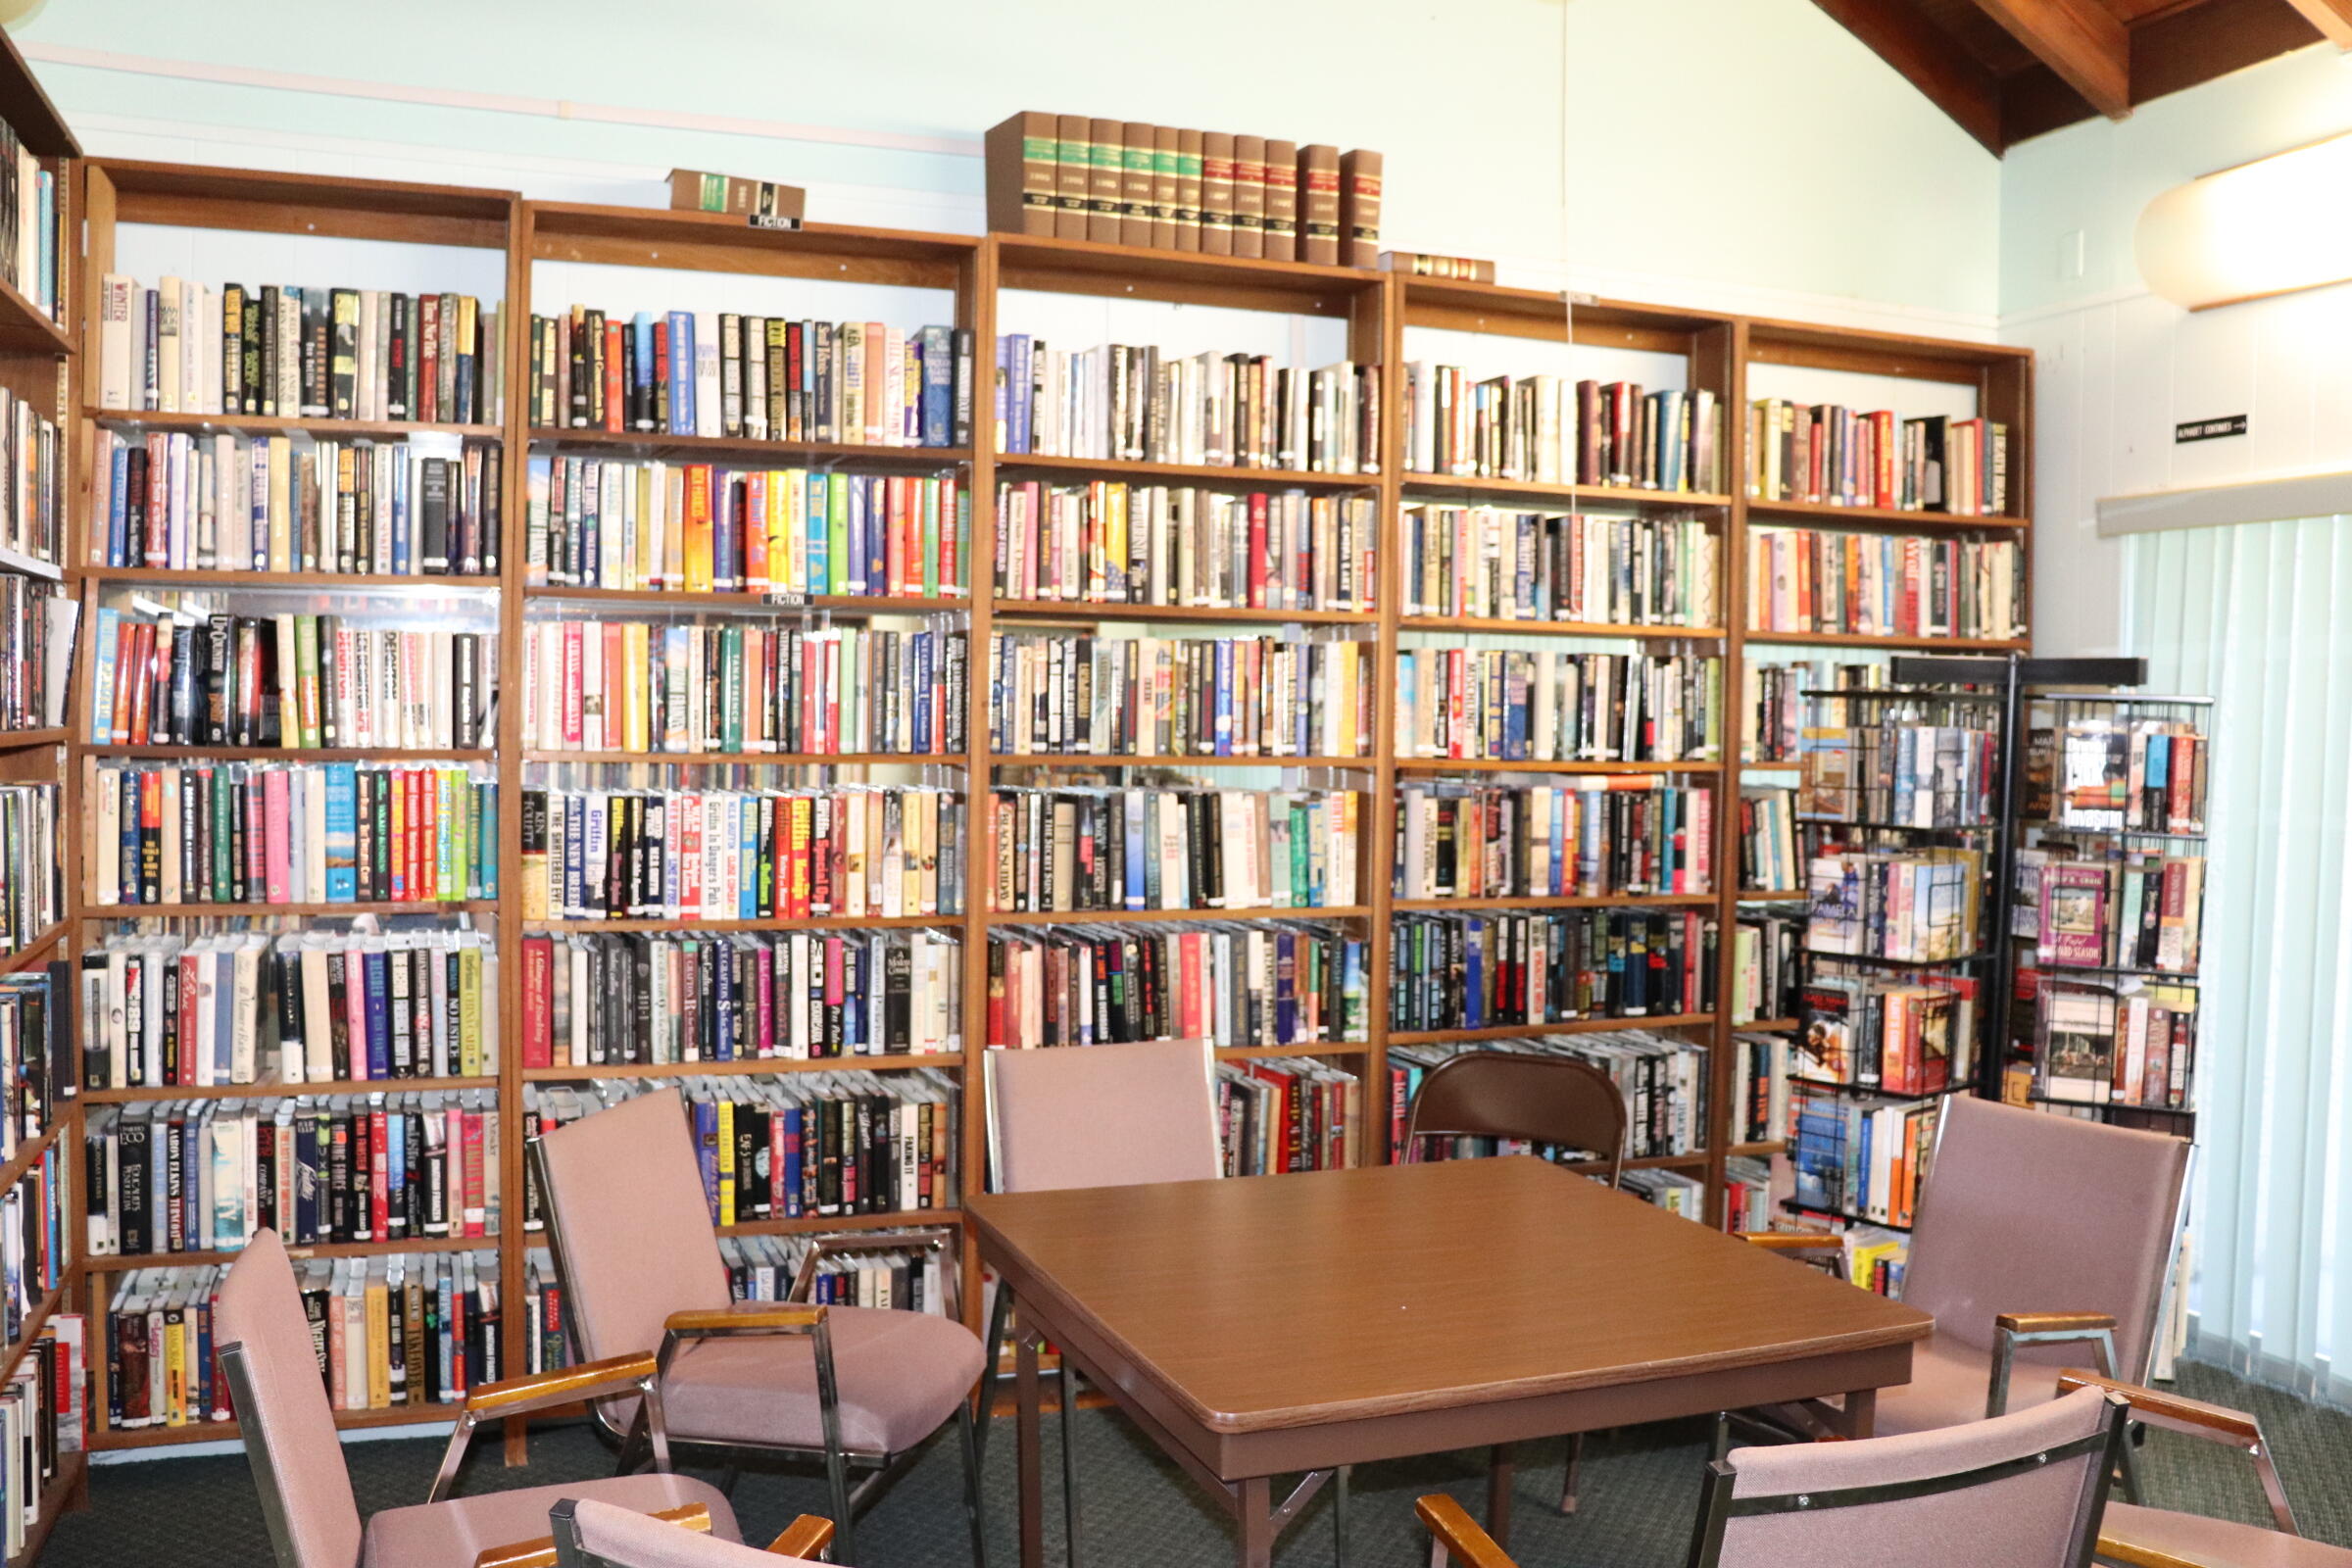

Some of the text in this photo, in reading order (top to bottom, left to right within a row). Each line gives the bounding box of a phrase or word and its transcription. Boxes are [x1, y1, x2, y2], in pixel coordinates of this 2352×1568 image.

[759, 216, 791, 228] FICTION
[114, 283, 128, 321] WINTER
[771, 594, 805, 606] FICTION
[1466, 663, 1476, 728] MISCHLING
[524, 801, 535, 844] FOLLETT
[535, 811, 545, 834] KEN
[553, 811, 563, 828] THE
[568, 815, 581, 840] THE
[591, 809, 603, 853] Griffin
[709, 802, 720, 830] Griffin
[793, 800, 812, 851] Griffin
[1001, 813, 1009, 853] BLACK
[553, 832, 563, 884] SHATTERED
[568, 842, 581, 868] NEW
[707, 846, 720, 882] Danger's
[709, 887, 720, 906] Path
[720, 960, 729, 999] GRAFTON
[1099, 1002, 1107, 1040] OVERBOARD
[170, 1129, 180, 1159] AARON
[904, 1137, 913, 1162] FAKING
[170, 1161, 180, 1196] ELKINS
